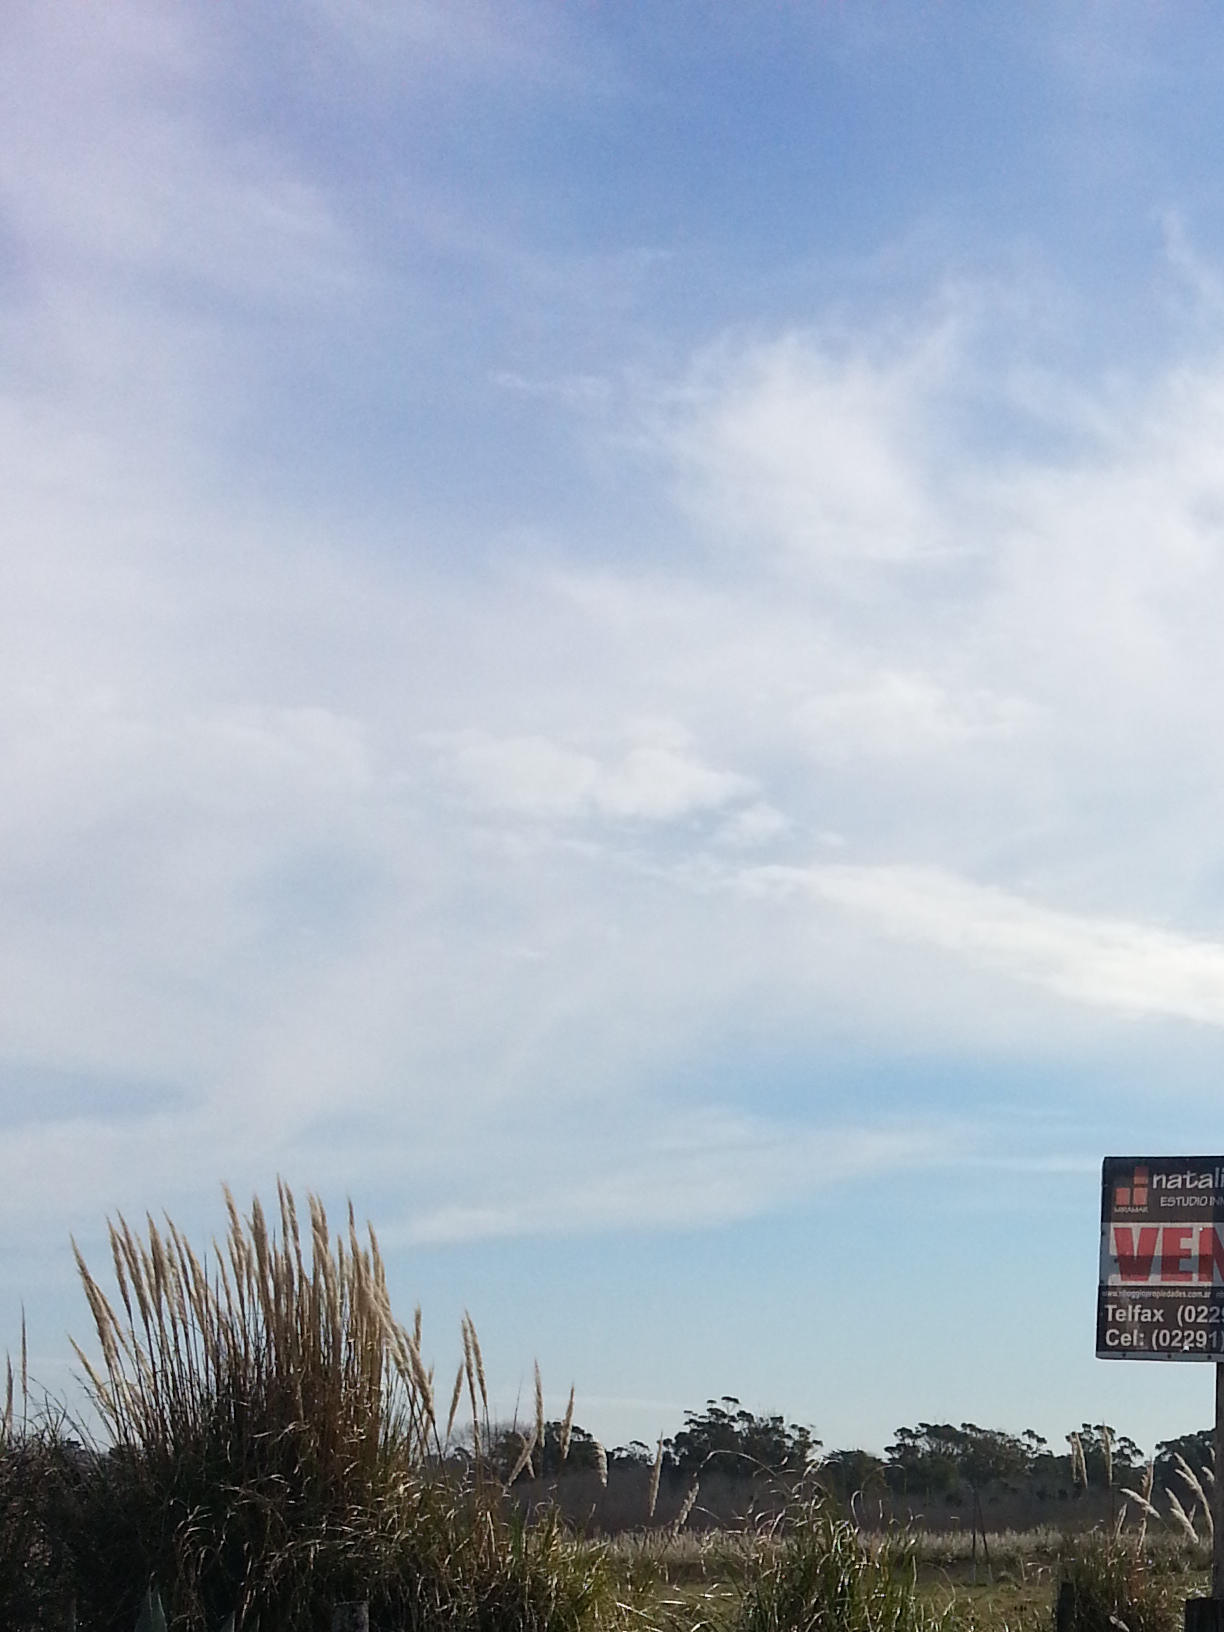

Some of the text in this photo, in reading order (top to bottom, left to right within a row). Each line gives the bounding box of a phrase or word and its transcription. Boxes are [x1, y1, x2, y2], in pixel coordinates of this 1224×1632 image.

[1160, 1195, 1208, 1207] ESTUDIO
[1105, 1304, 1164, 1322] Telfax
[1105, 1329, 1145, 1347] Cel:
